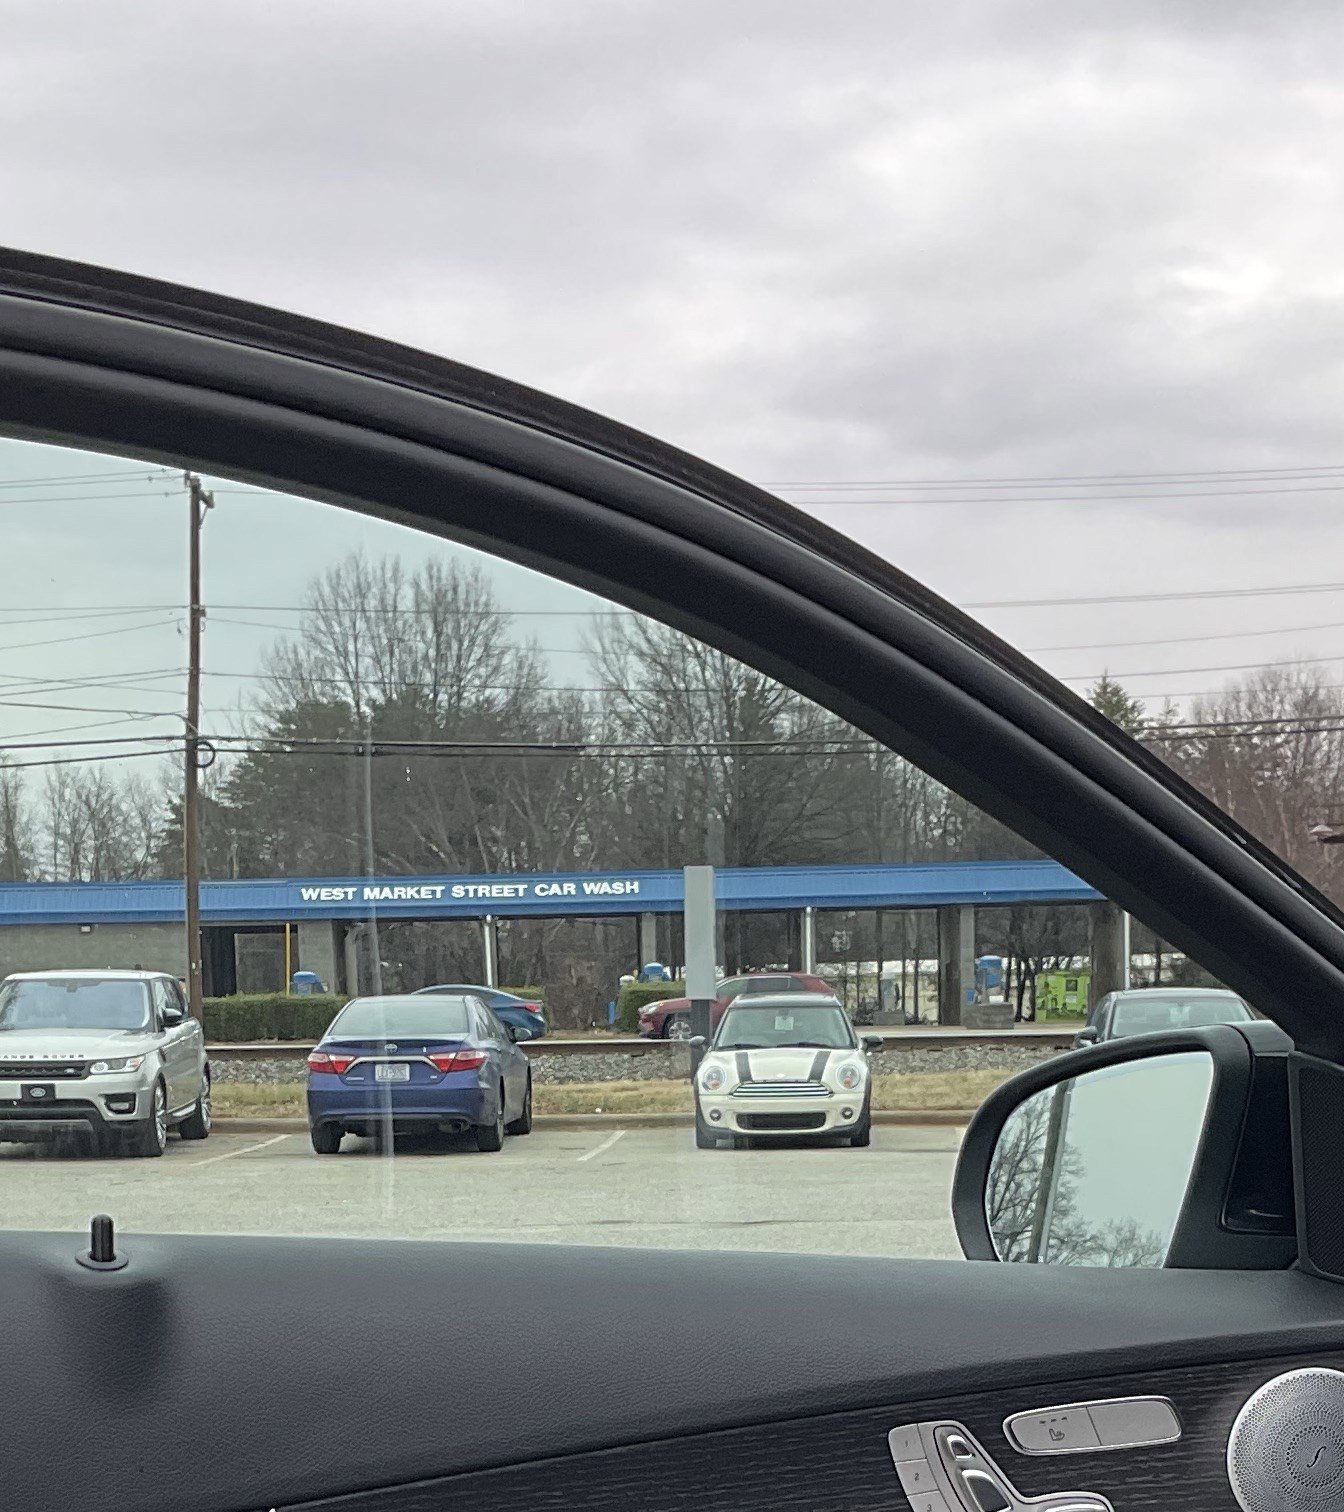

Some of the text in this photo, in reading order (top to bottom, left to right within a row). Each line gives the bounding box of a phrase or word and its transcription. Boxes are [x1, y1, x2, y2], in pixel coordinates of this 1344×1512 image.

[301, 881, 640, 901] WEST MARKET STREET CAR WASH
[926, 1503, 932, 1512] 3
